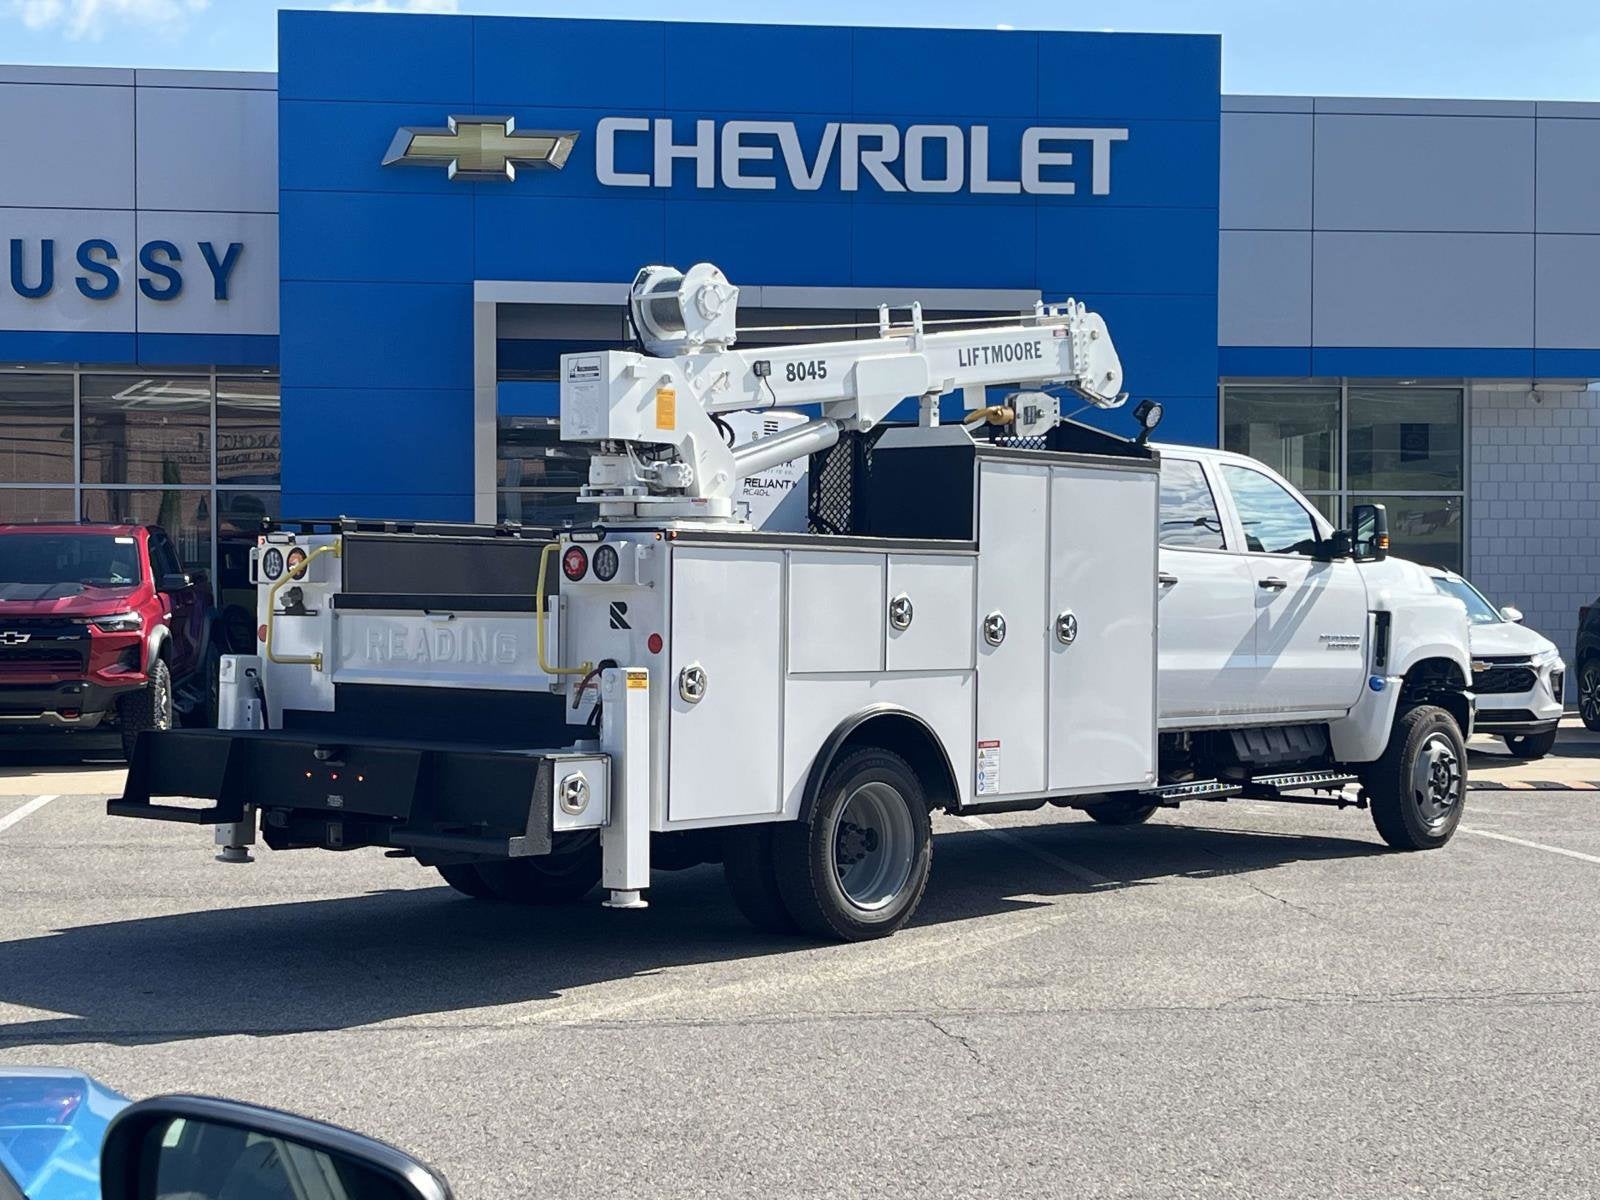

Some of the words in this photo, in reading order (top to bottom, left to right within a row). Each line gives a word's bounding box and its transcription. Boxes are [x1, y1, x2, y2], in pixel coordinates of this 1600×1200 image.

[596, 116, 1129, 196] CHEVROLET
[10, 238, 244, 301] USSY
[958, 341, 1043, 368] LIFTMOORE
[786, 360, 828, 382] 8045
[743, 477, 791, 490] RELIANT
[365, 627, 519, 665] READING
